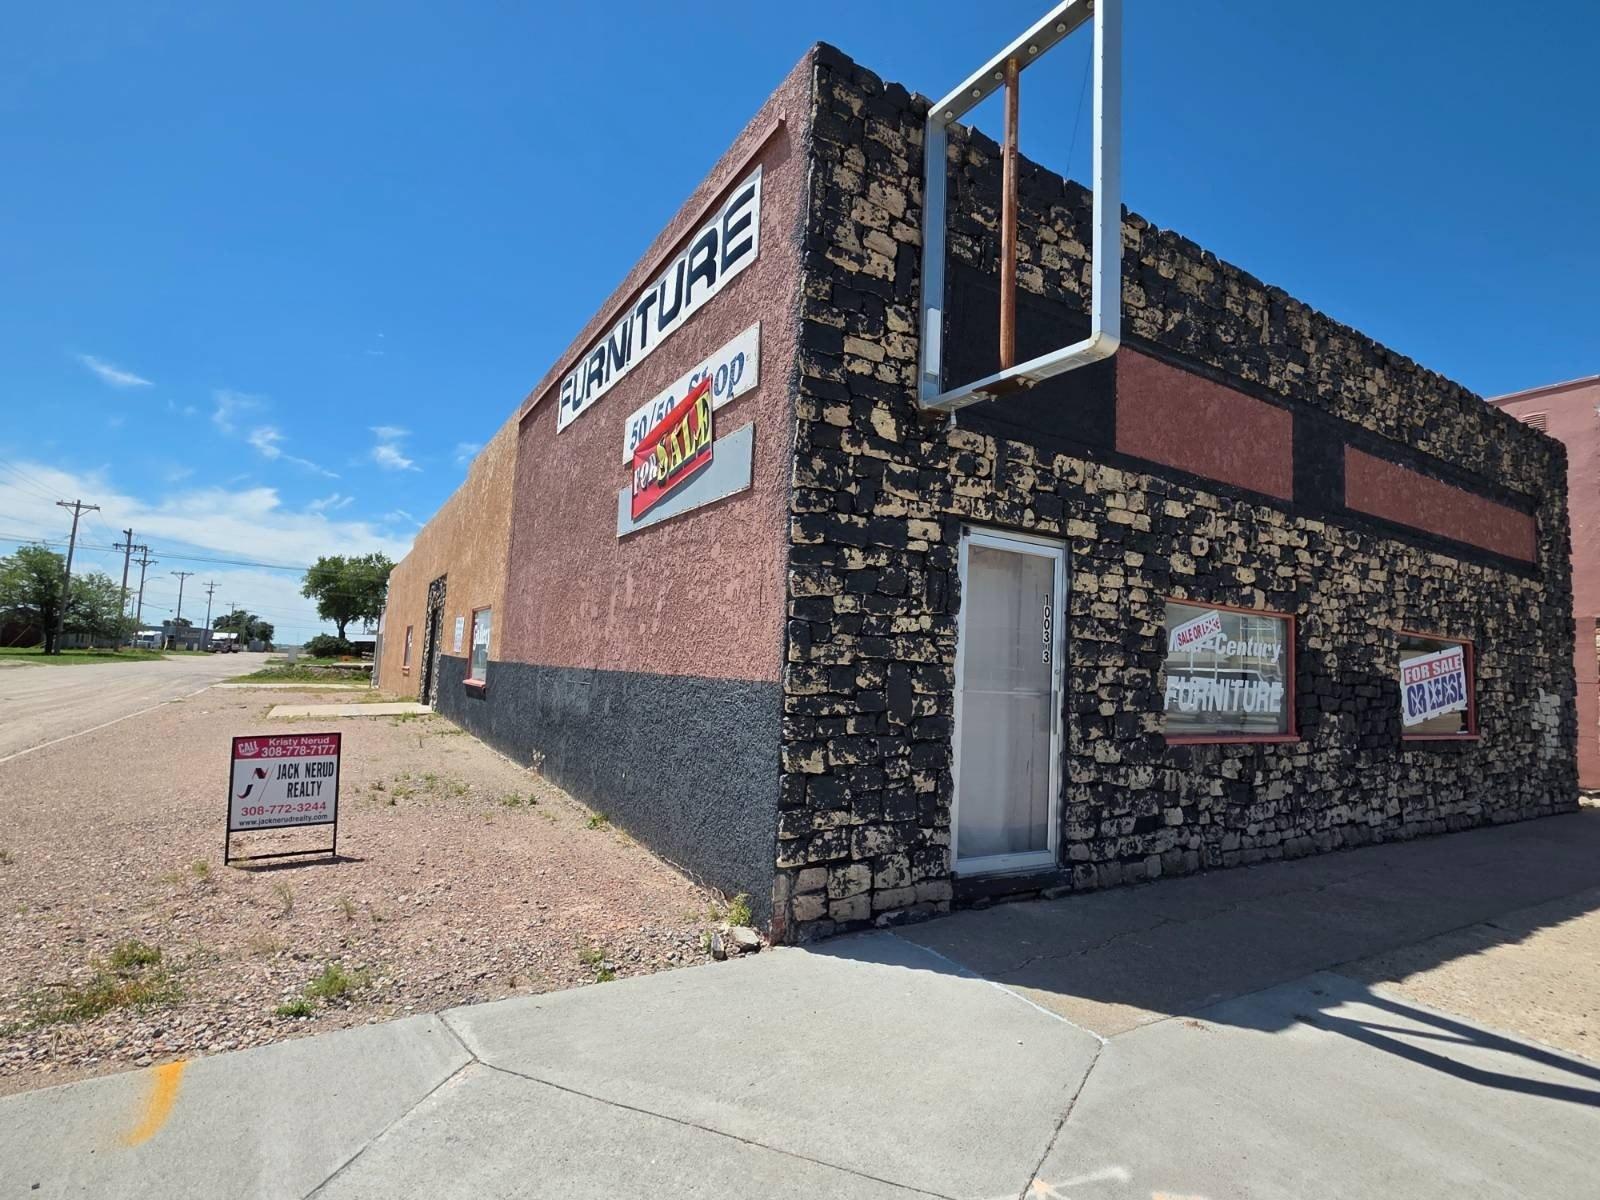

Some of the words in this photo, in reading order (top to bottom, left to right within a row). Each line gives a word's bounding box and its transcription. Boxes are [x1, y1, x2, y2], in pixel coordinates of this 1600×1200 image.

[560, 184, 755, 424] FURNITURE
[688, 351, 745, 399] Sop
[634, 453, 657, 496] FOR
[1177, 629, 1193, 647] SALE
[1193, 625, 1203, 639] OR
[1405, 664, 1429, 683] FOR
[1431, 656, 1461, 675] SALE
[1164, 676, 1283, 712] FURNITURE
[238, 741, 258, 754] CALL
[261, 745, 336, 757] 308-778-7177
[269, 738, 297, 747] Kristy
[301, 737, 330, 745] Nerud
[277, 762, 300, 780] JACK
[305, 762, 334, 778] NERUD
[287, 781, 322, 798] REALTY
[241, 802, 327, 816] 308-772-3244
[239, 814, 328, 826] www.jacknerudrealty.com
